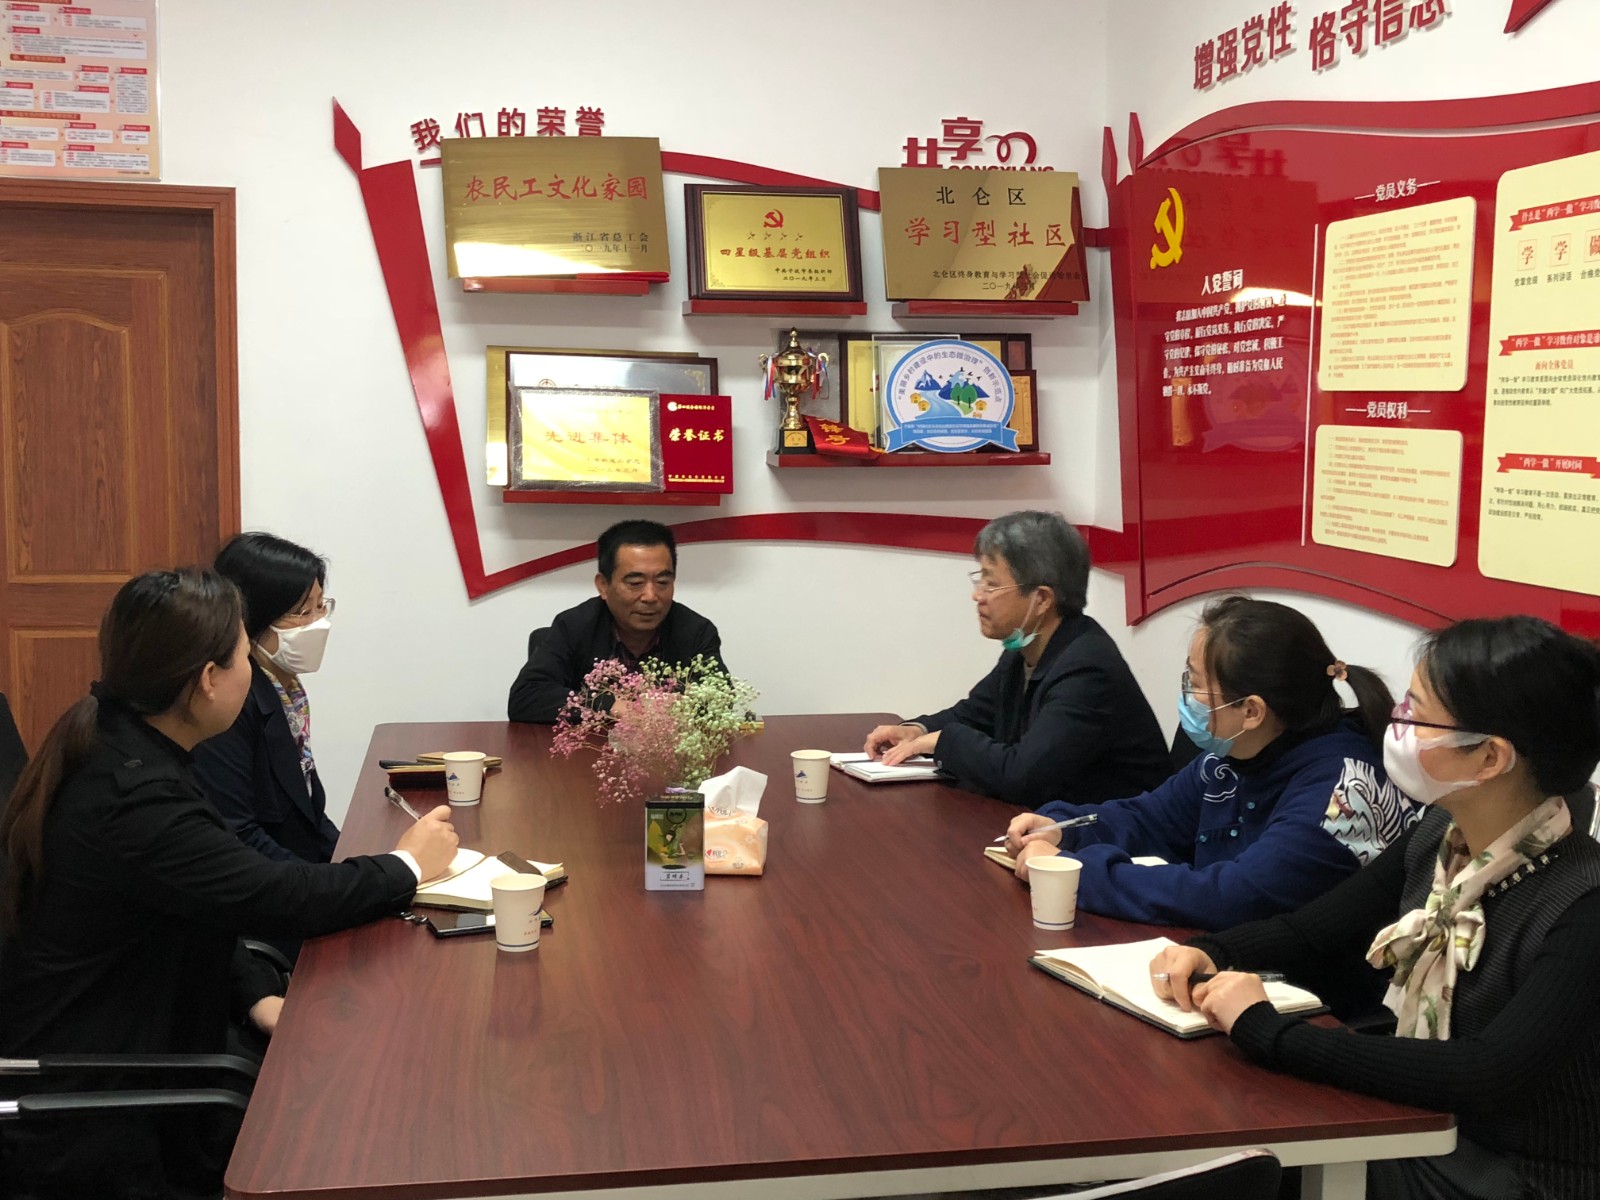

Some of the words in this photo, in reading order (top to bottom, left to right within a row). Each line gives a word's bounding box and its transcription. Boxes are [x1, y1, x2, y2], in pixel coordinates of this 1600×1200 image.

[1193, 1, 1292, 90] 增强党性
[410, 106, 605, 150] 我们的荣誉
[901, 117, 984, 168] 共享
[465, 173, 648, 200] 农民工文化家园
[936, 186, 1027, 207] 北仑区
[1375, 178, 1418, 203] 党员义务
[572, 232, 649, 242] 浙江省总工会
[904, 218, 1067, 248] 学习型社区
[720, 246, 831, 260] 四星级基层党组织
[1521, 245, 1534, 265] 学
[1554, 240, 1568, 261] 学
[1366, 401, 1408, 420] 党员权利
[545, 431, 632, 445] 先进集体
[669, 427, 725, 442] 荣誉证书
